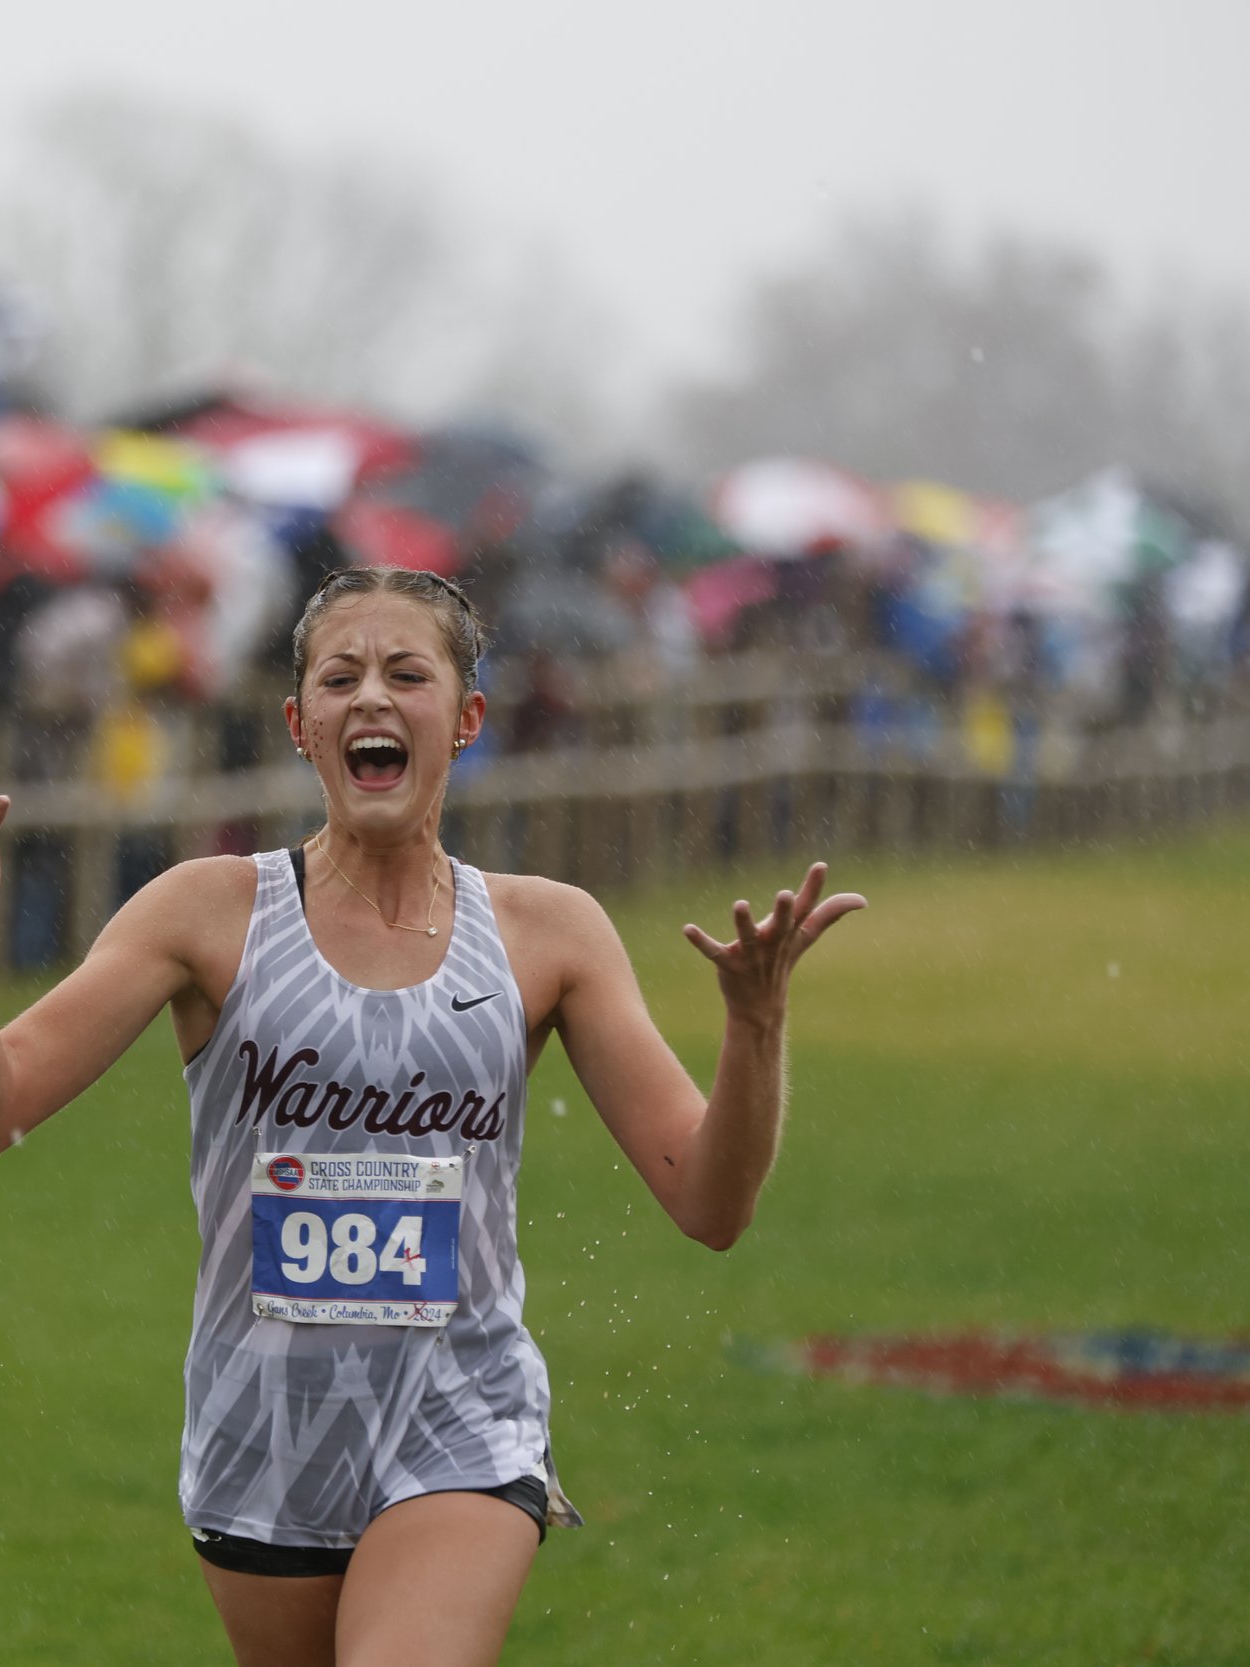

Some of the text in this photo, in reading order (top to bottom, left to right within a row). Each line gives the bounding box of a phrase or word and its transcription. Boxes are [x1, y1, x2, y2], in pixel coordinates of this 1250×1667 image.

[235, 1040, 506, 1141] Warriors
[311, 1161, 420, 1178] CROSS COUNTRY
[309, 1178, 338, 1191] STATE
[342, 1179, 421, 1192] CHAMPIONSHIP
[281, 1211, 426, 1285] 984
[267, 1301, 288, 1317] Gans
[291, 1303, 318, 1318] Creek
[329, 1304, 378, 1321] Columbia,
[381, 1306, 400, 1320] Mo
